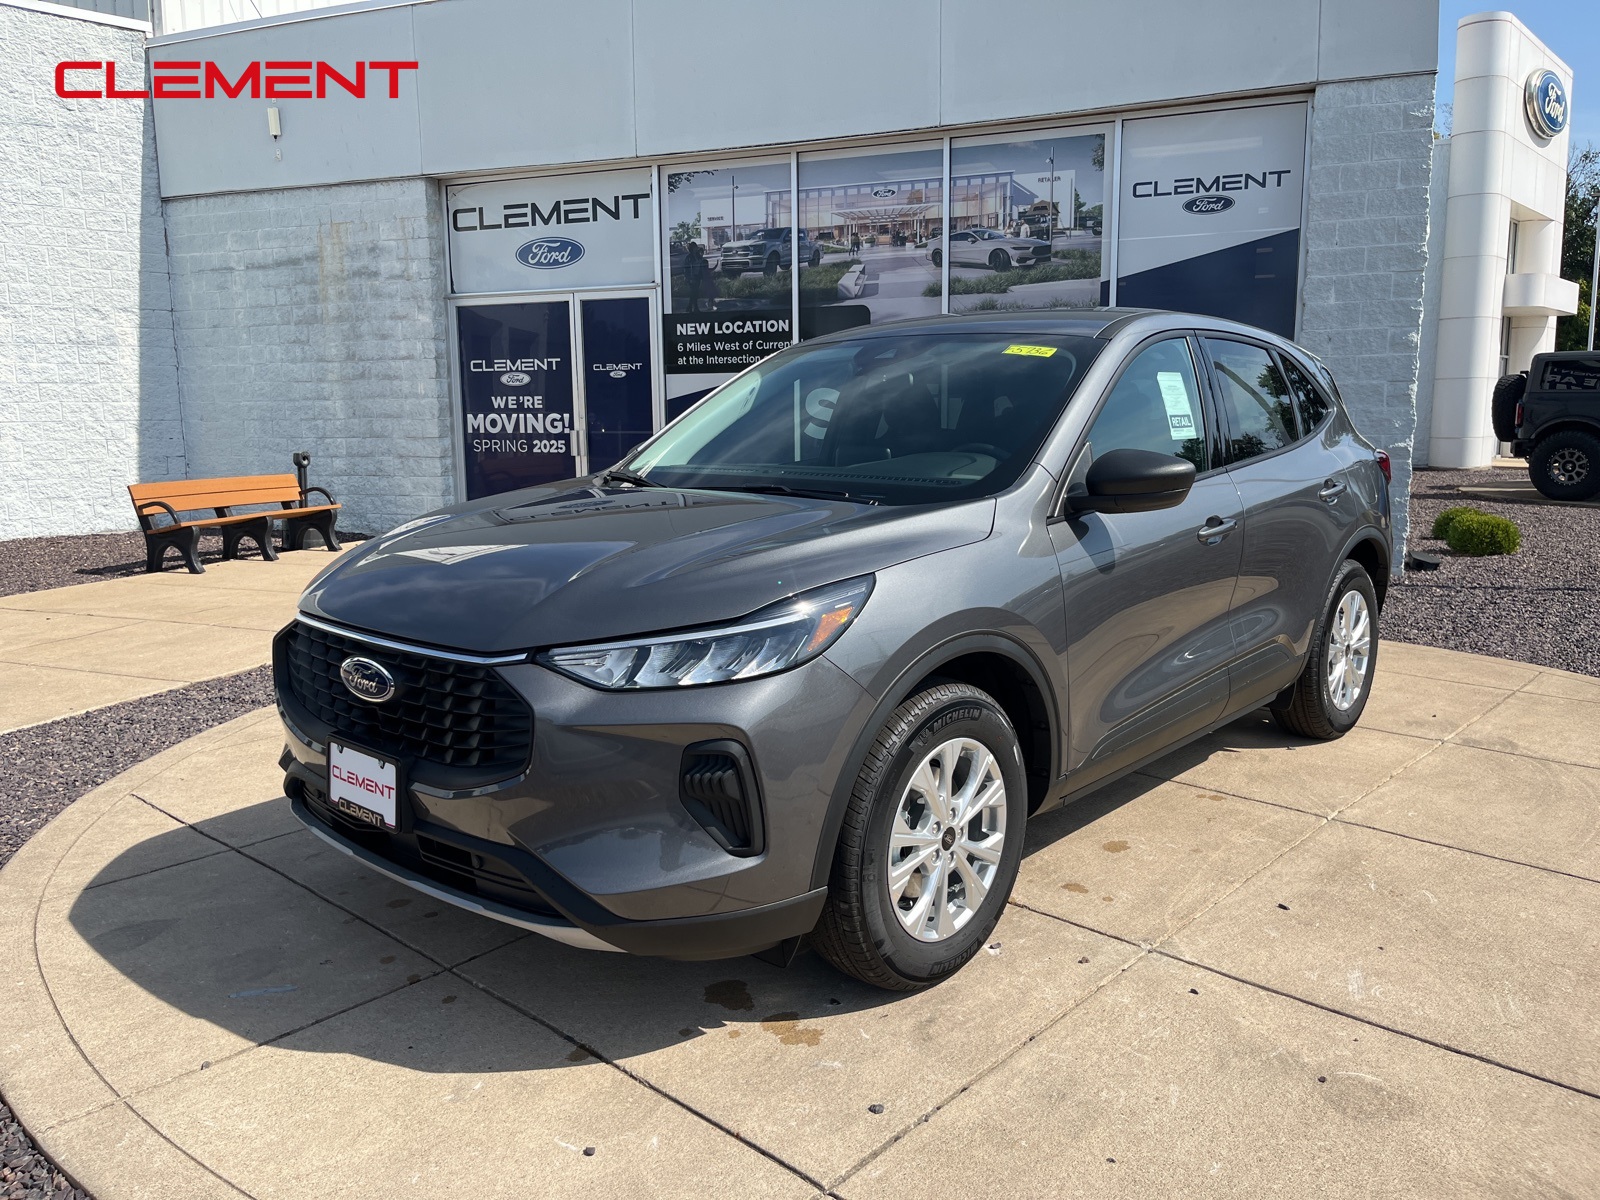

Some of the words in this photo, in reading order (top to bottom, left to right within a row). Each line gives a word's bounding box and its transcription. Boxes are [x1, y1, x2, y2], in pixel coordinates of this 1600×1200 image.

[1132, 169, 1291, 198] CLEMENT
[452, 192, 651, 233] CLEMENT
[676, 322, 711, 336] NEW
[714, 319, 789, 335] LOCATION
[677, 343, 684, 352] 6
[686, 342, 711, 352] Miles
[714, 341, 740, 351] West
[742, 340, 753, 350] of
[470, 358, 561, 372] CLEMENT
[593, 363, 643, 371] CLEMENT
[677, 356, 687, 365] at
[689, 355, 704, 365] the
[706, 354, 761, 365] Intersection
[491, 396, 543, 409] WE'RE
[466, 412, 570, 434] MOVING!
[1171, 416, 1192, 427] RETAIL
[473, 439, 528, 453] SPRING
[533, 440, 566, 453] 2025
[933, 708, 981, 733] MICHELIN
[332, 764, 395, 800] CLEMENT
[339, 799, 383, 827] CLEMENT
